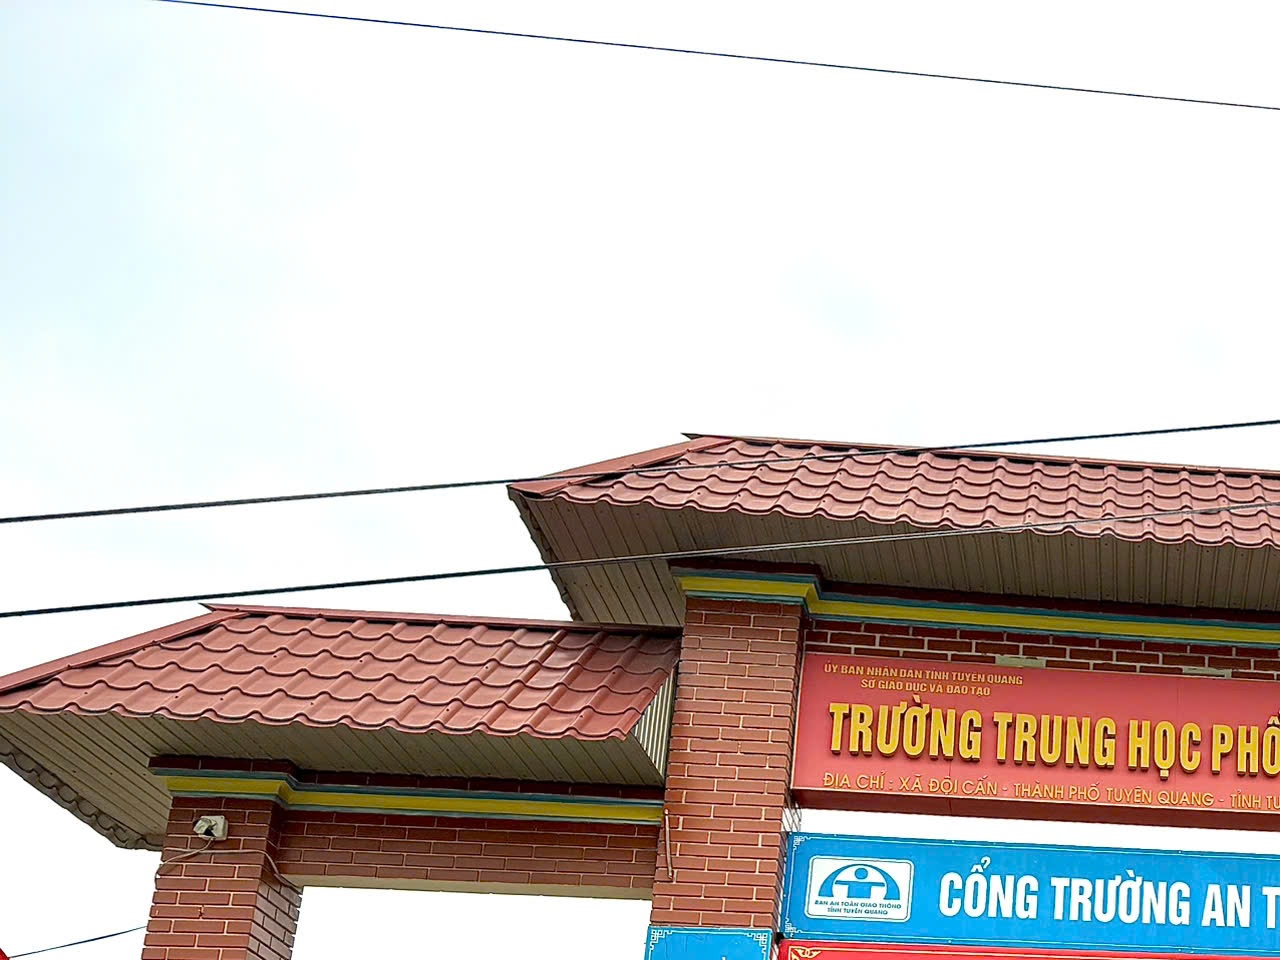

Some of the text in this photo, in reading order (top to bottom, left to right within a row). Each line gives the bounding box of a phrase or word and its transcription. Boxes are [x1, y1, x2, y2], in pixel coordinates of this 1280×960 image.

[828, 694, 983, 761] TRƯỜNG
[992, 711, 1117, 768] TRUNG
[1128, 719, 1202, 780] HỌC
[939, 856, 1039, 919] CỔNG
[1050, 869, 1191, 926] TRƯỜNG
[1201, 884, 1251, 928] AN
